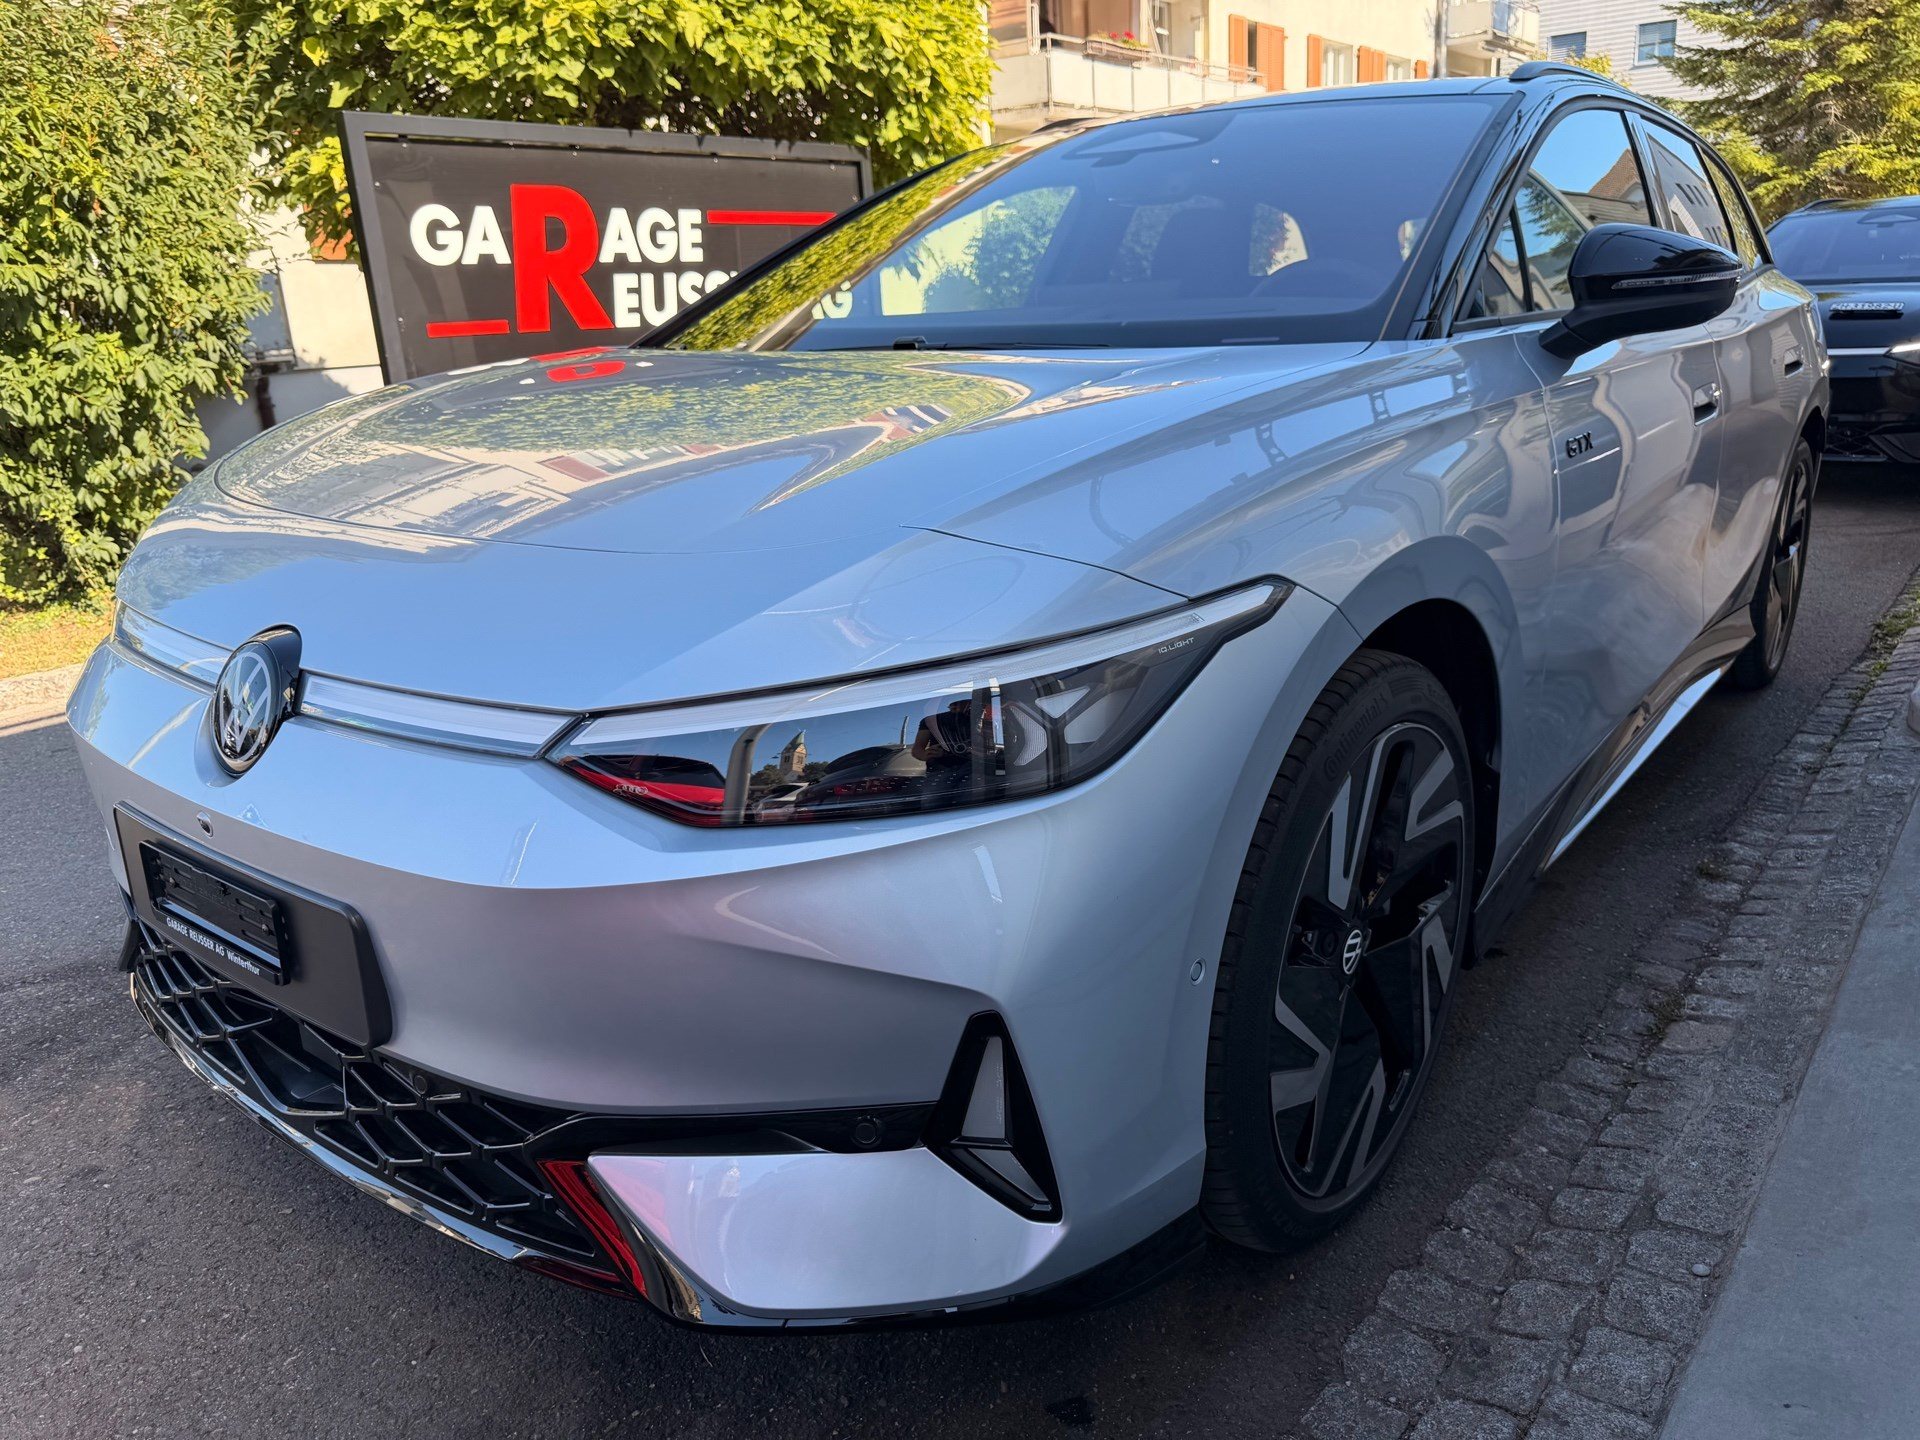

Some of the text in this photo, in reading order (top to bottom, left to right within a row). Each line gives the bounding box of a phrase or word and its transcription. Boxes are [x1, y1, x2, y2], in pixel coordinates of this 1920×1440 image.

[409, 183, 704, 333] GARAGE
[1565, 431, 1594, 459] GTX
[166, 917, 261, 976] GARAGE REUSSER AG Winterthur
